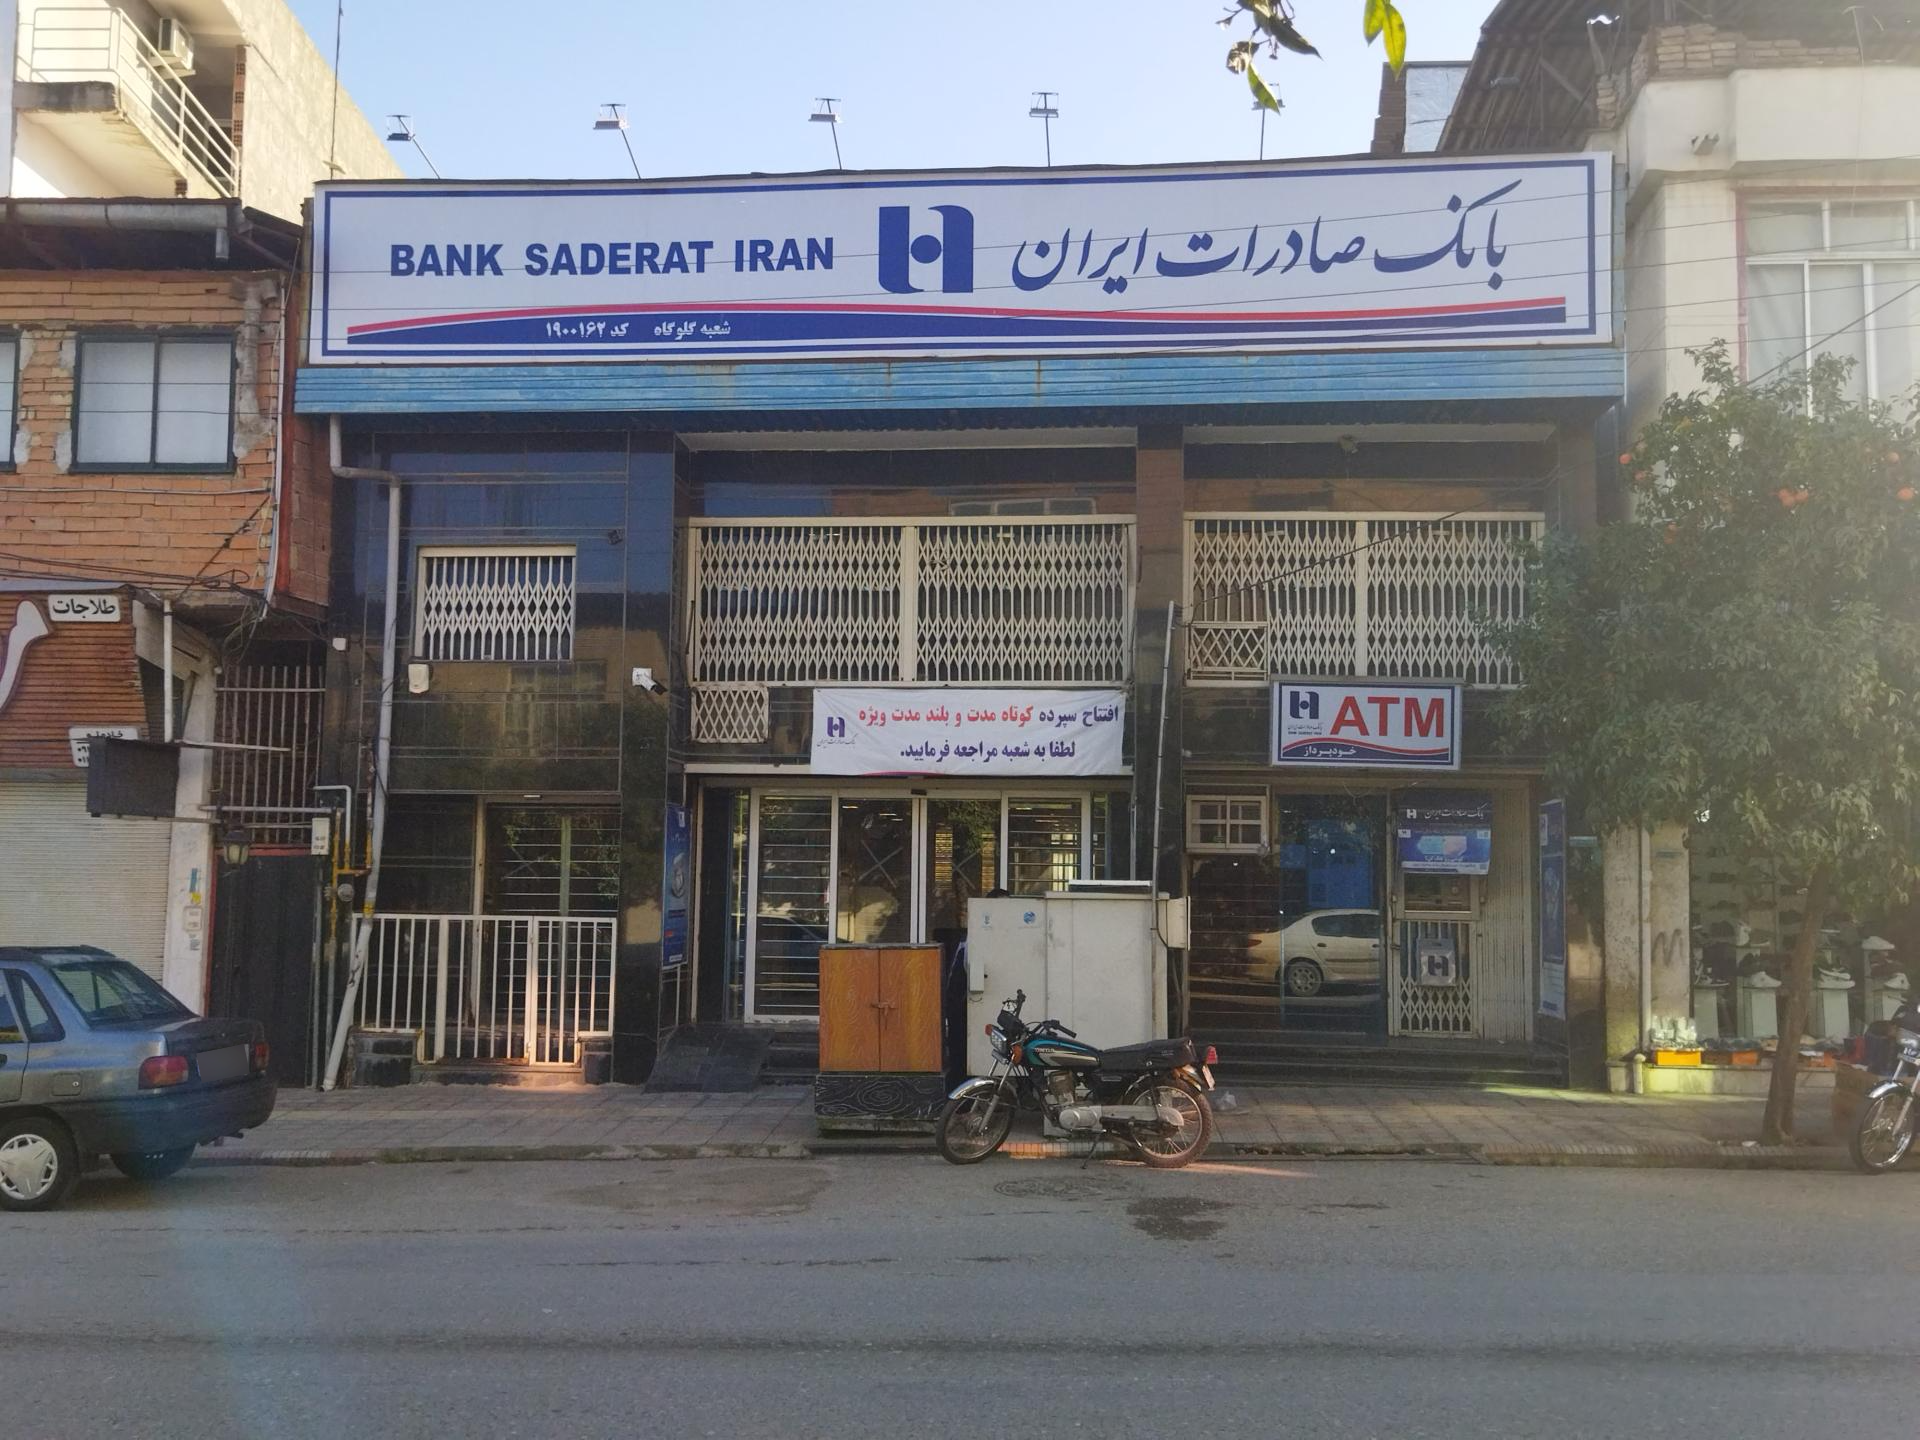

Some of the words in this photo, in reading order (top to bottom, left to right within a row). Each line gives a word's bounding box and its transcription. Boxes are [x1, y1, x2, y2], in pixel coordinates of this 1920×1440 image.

[1374, 178, 1523, 290] بانک
[390, 243, 504, 277] BANK
[525, 240, 714, 276] SADERAT
[734, 237, 834, 273] IRAN
[1155, 215, 1367, 278] صادرات
[1011, 227, 1149, 295] ایران
[610, 322, 630, 337] کد
[654, 320, 697, 341] گلوگاه
[700, 321, 731, 339] شعبه
[52, 598, 116, 619] طلاجات
[859, 706, 886, 727] ویژه
[891, 709, 920, 721] مدت
[926, 705, 949, 726] بلند
[954, 711, 961, 727] و
[967, 709, 996, 721] مدت
[1001, 706, 1033, 727] کوتاه
[1039, 710, 1077, 728] سپرده
[1082, 705, 1119, 727] افتتاح
[1329, 695, 1445, 738] ATM
[953, 741, 998, 763] مراجعه
[1001, 742, 1030, 761] شعبه
[1034, 745, 1046, 761] به
[1049, 741, 1075, 758] لطفا
[1303, 745, 1357, 758] خودپرداز
